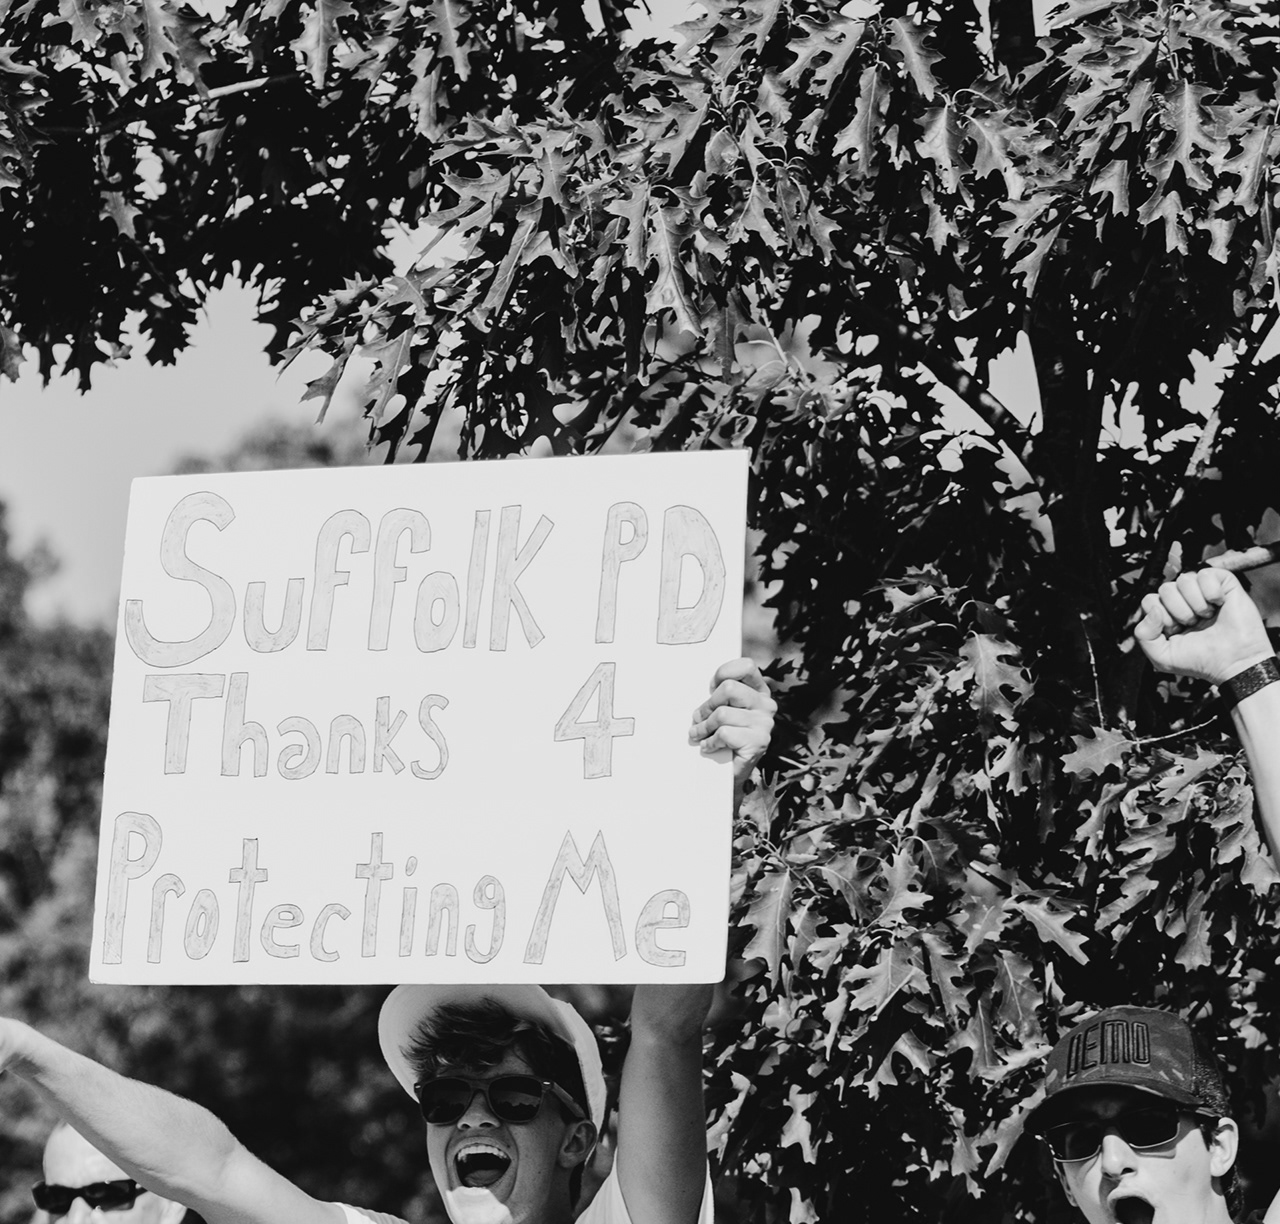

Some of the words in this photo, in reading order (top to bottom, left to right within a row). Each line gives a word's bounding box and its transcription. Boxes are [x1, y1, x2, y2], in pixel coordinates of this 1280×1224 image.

[594, 501, 726, 646] PD
[553, 662, 636, 780] 4
[102, 812, 506, 965] Protecting
[523, 830, 691, 968] Me
